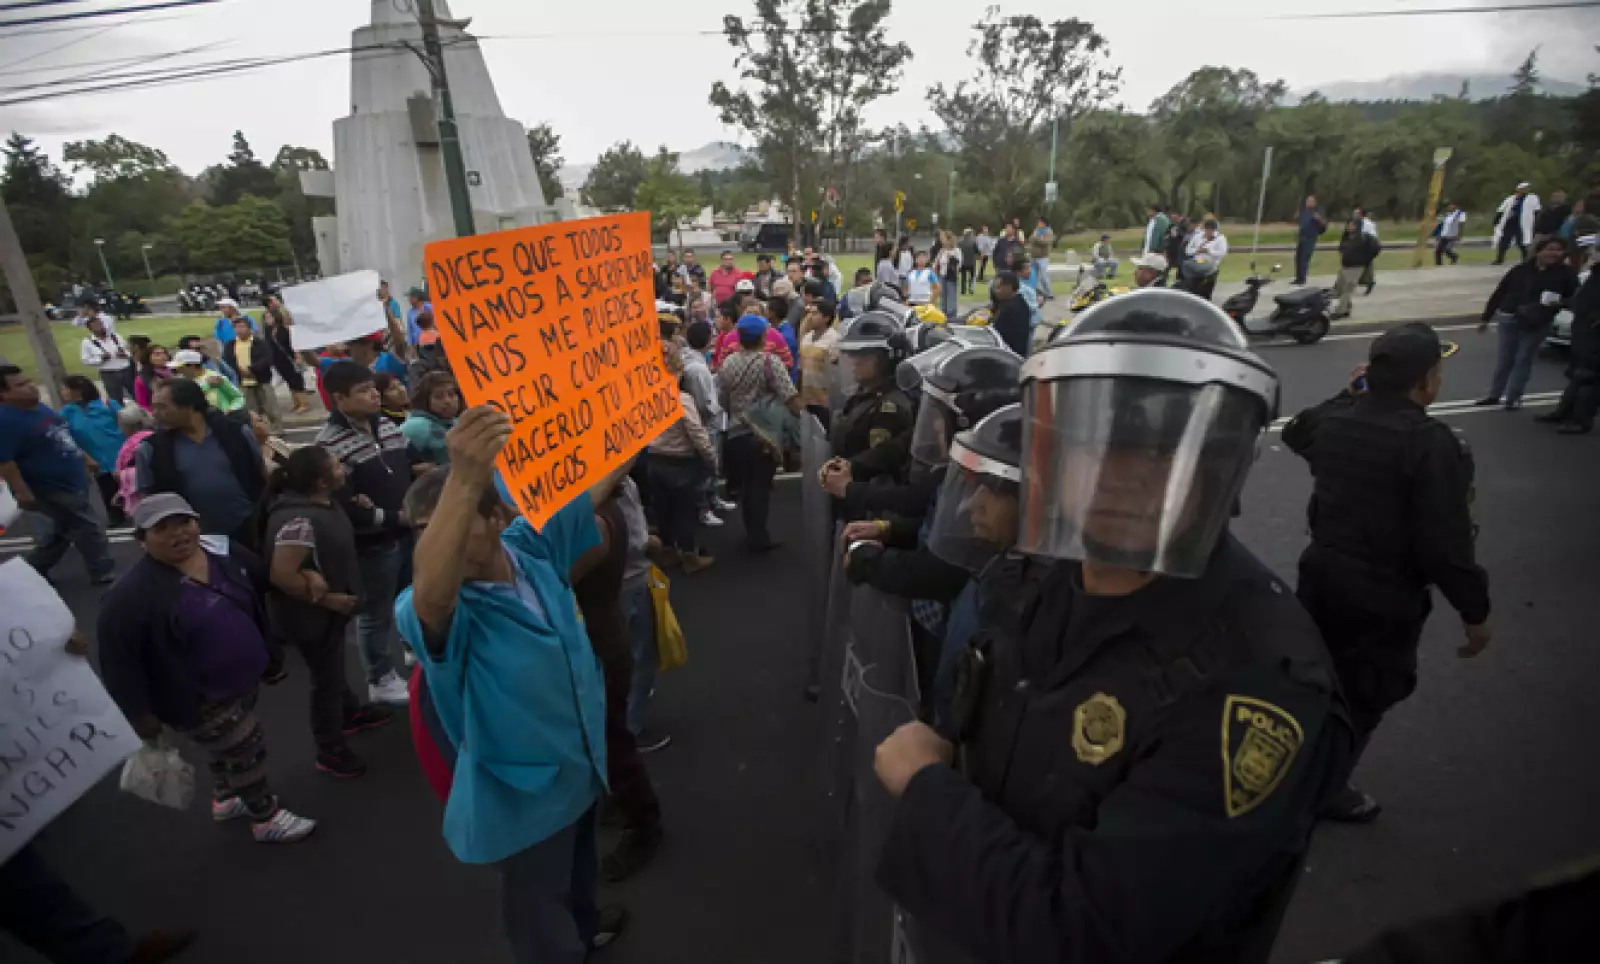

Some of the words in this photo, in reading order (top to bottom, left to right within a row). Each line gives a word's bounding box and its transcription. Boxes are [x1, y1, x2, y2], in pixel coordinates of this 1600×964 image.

[431, 247, 504, 300] DICES
[512, 236, 561, 276] QUE
[565, 223, 622, 260] TODOS
[443, 281, 544, 343] VAMOS
[555, 274, 573, 305] A
[464, 334, 527, 390] NOS
[539, 315, 578, 357] ME
[583, 289, 643, 338] PUEDES
[570, 337, 619, 389] COMO
[503, 399, 593, 479] HACERLO
[596, 381, 620, 417] TU
[519, 445, 587, 517] AMIGOS
